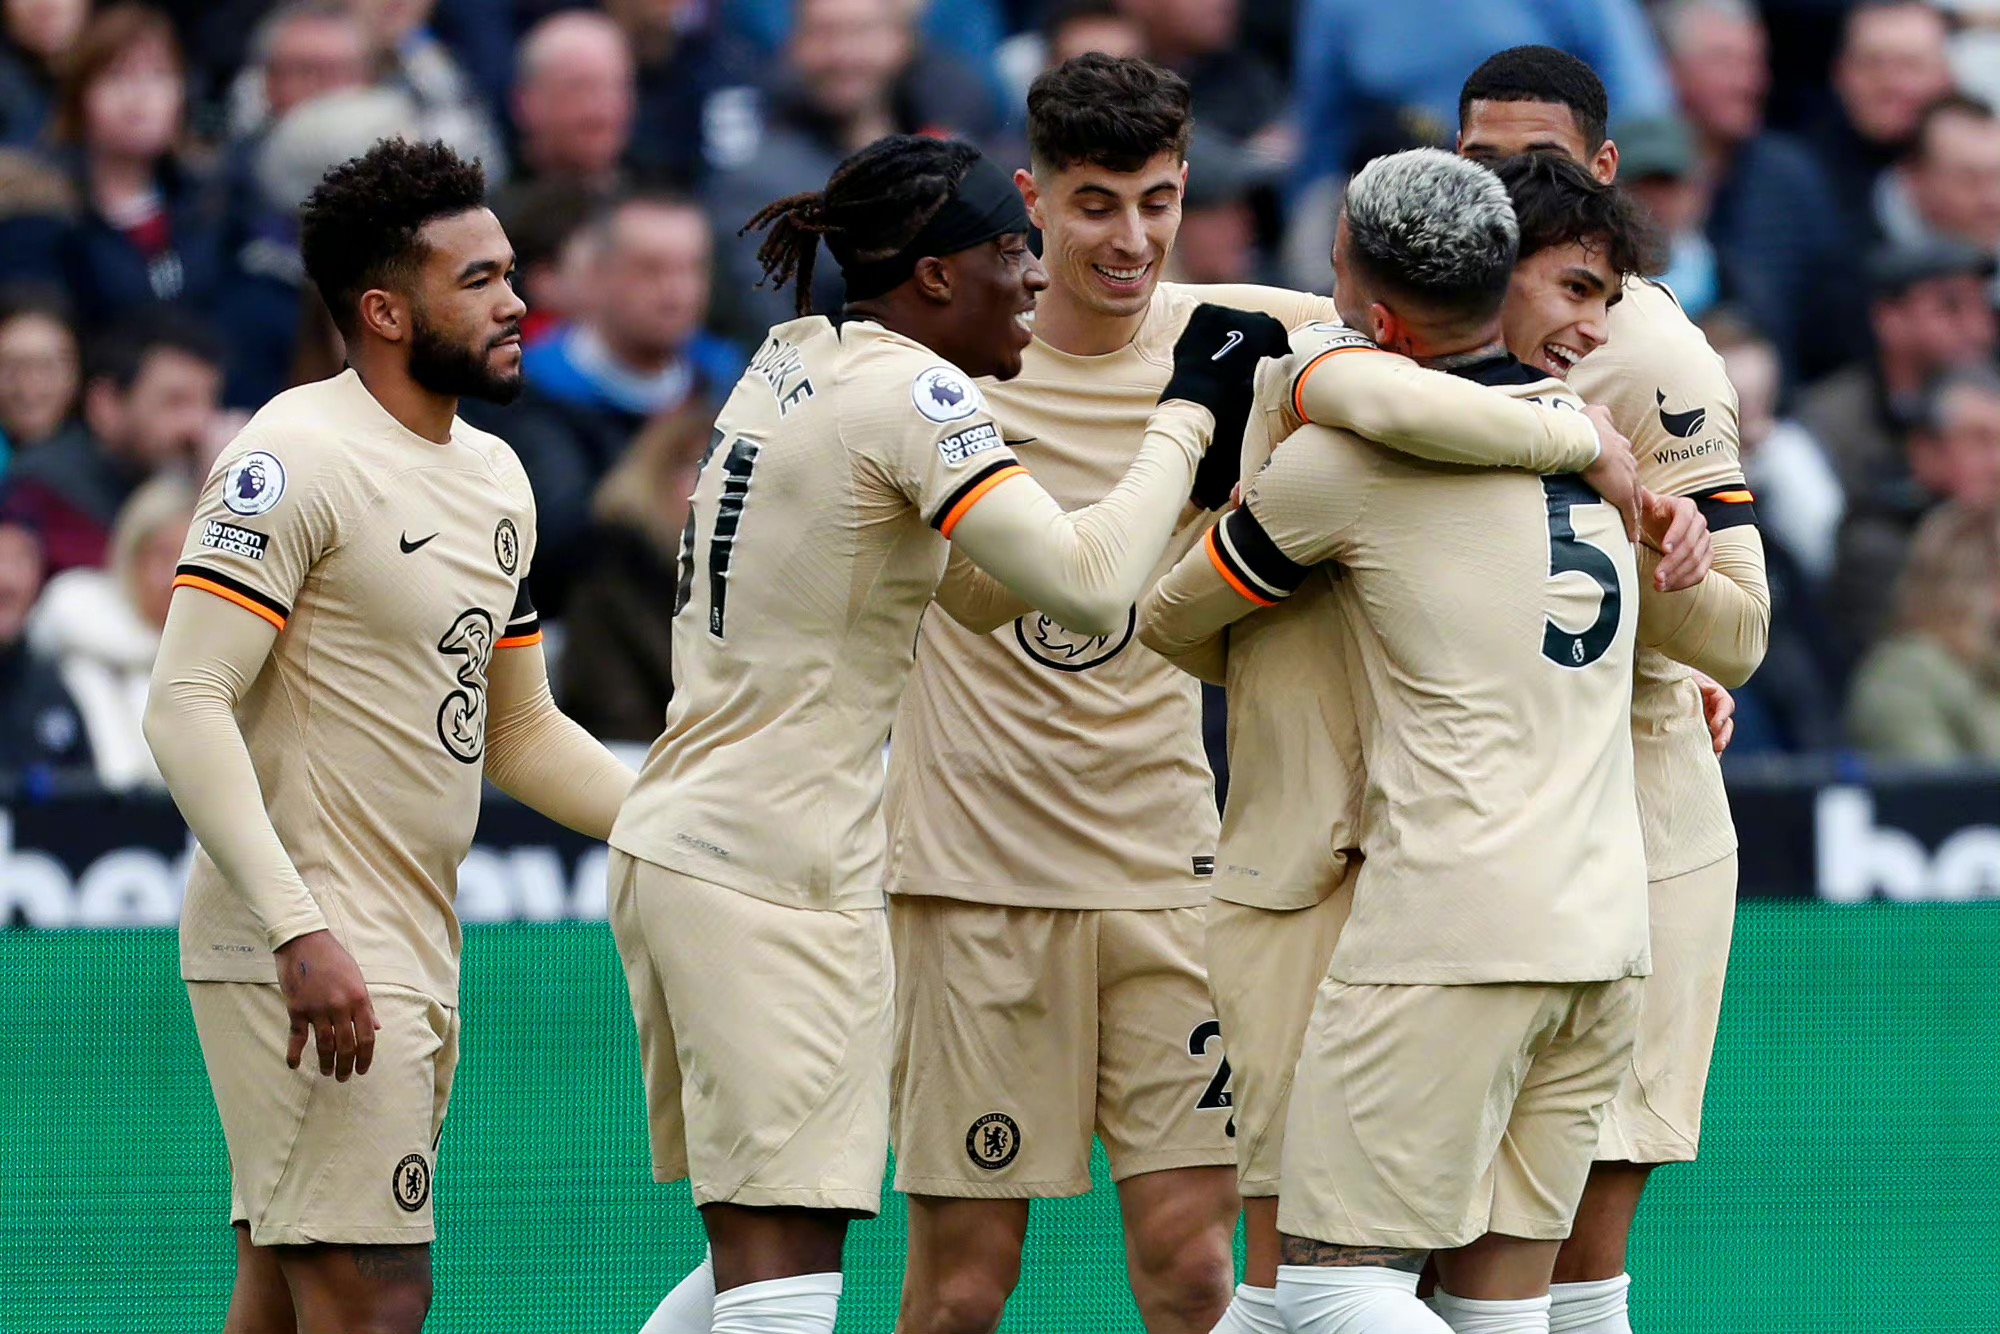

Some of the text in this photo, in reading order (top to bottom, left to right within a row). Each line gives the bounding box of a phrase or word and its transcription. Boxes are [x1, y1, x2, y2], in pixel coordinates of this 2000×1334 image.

[938, 425, 996, 454] No room
[1653, 438, 1724, 464] WhaleFin
[203, 520, 262, 547] No room
[200, 535, 264, 560] for racism
[1540, 473, 1622, 671] 5
[1188, 1017, 1237, 1139] 2
[976, 1114, 1012, 1127] CHELSEA
